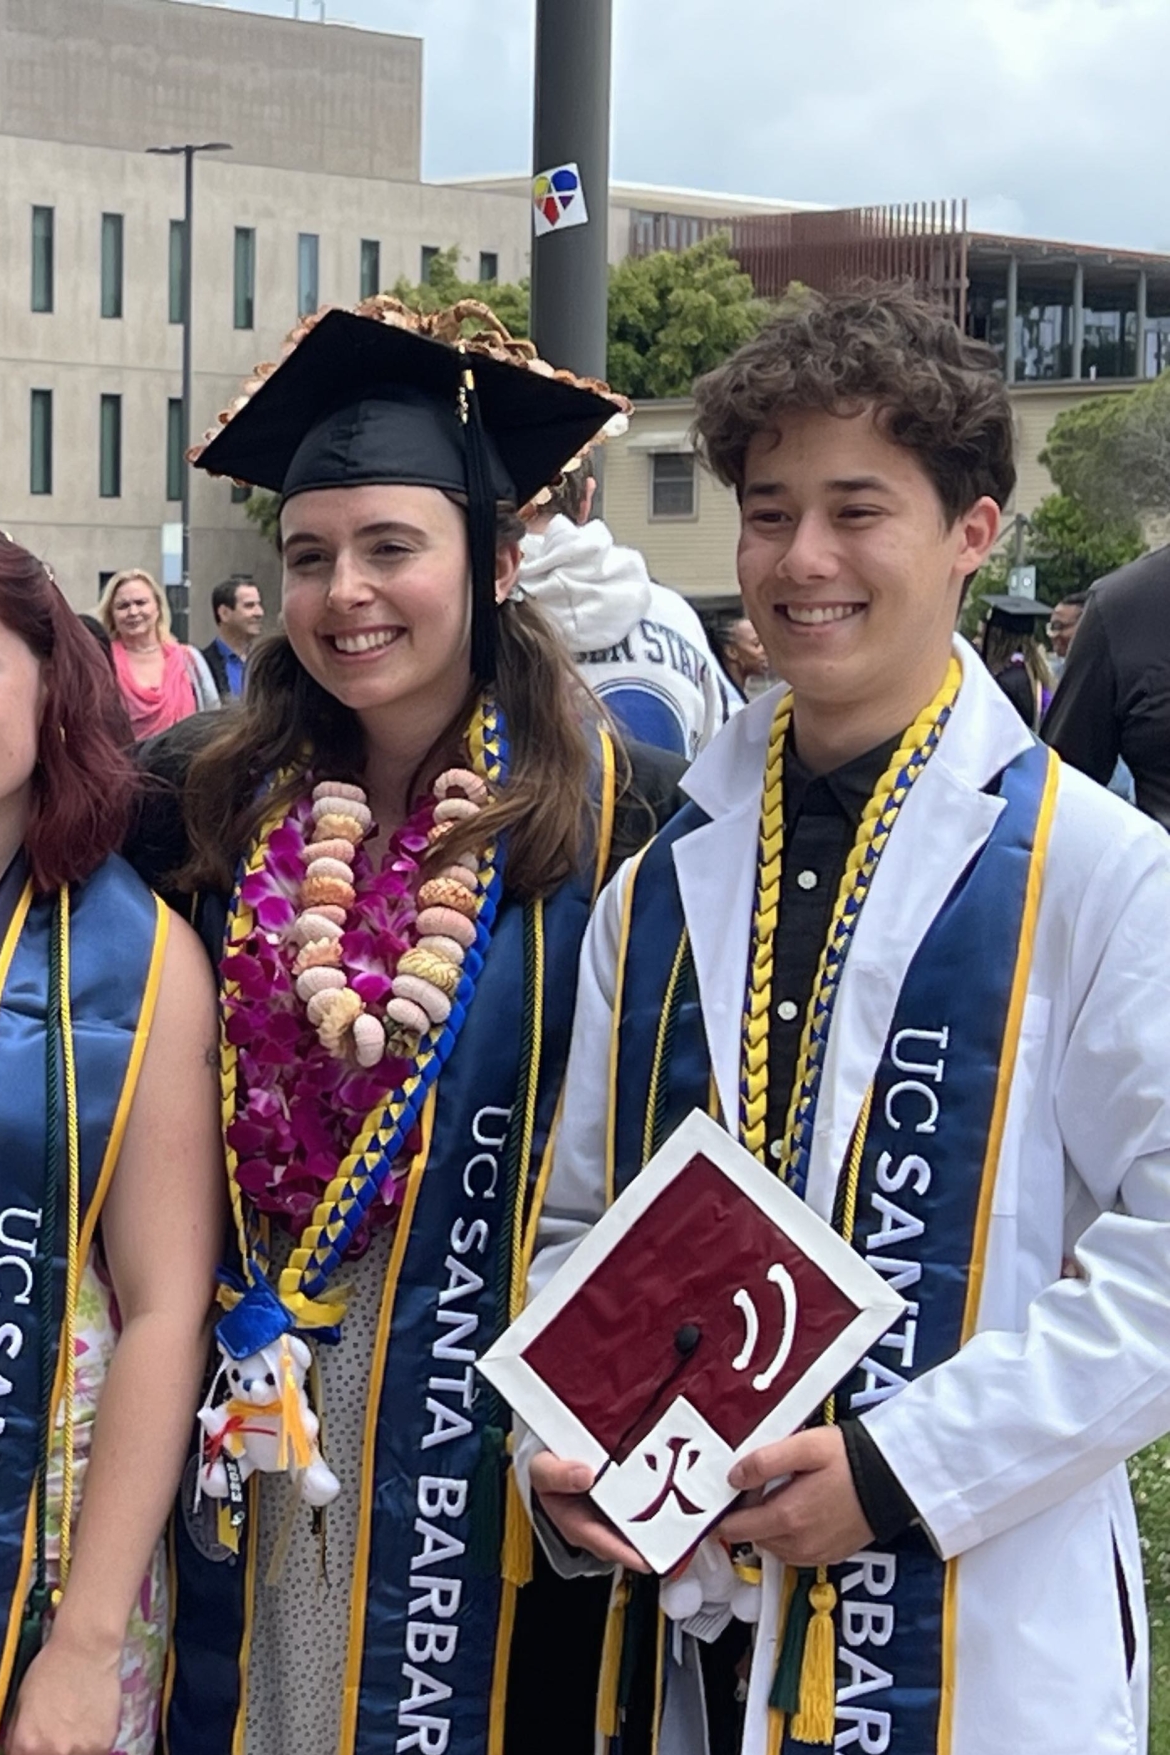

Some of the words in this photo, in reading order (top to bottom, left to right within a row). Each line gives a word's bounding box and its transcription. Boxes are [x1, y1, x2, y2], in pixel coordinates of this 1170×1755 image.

[884, 1026, 950, 1134] UC
[463, 1104, 513, 1200] UC
[421, 1217, 488, 1450] SANTA
[629, 1437, 706, 1523] 火
[396, 1475, 467, 1755] BARBAR
